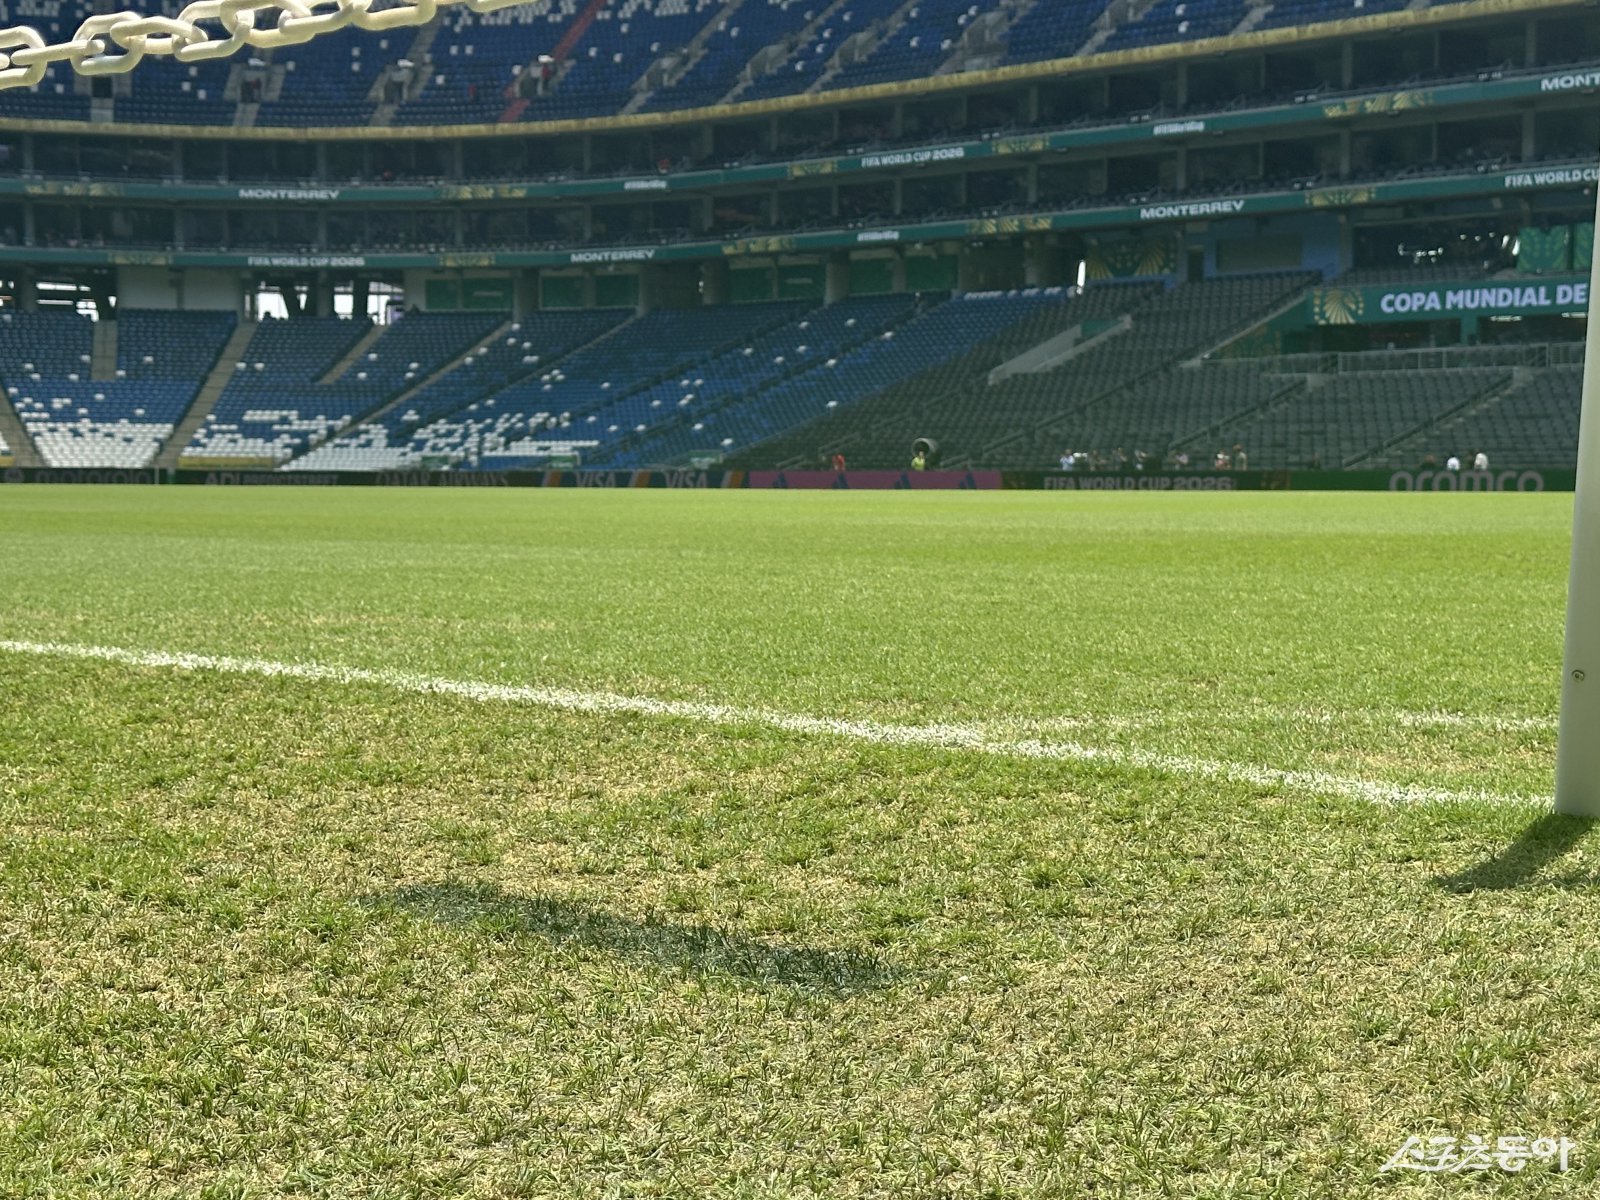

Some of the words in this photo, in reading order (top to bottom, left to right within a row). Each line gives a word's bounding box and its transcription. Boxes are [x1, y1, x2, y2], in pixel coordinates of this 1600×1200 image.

[861, 156, 881, 168] FIFA
[881, 153, 912, 166] WORLD
[913, 151, 932, 163] CUP
[932, 147, 965, 160] 2026
[1504, 174, 1533, 188] FIFA
[1534, 169, 1581, 185] WORLD
[238, 189, 340, 200] MONTERREY
[1139, 200, 1245, 219] MONTERREY
[247, 256, 271, 267] FIFA
[271, 256, 308, 267] WORLD
[309, 256, 329, 267] CUP
[330, 256, 366, 267] 2026
[570, 249, 655, 263] MONTERREY
[1380, 292, 1442, 314] COPA
[1445, 286, 1551, 310] MUNDIAL
[1555, 283, 1588, 305] DE
[573, 471, 616, 488] VISA
[663, 471, 708, 488] VISA
[1042, 476, 1076, 490] FIFA
[1077, 476, 1136, 490] WORLD
[1138, 476, 1171, 490] CUP
[1172, 475, 1233, 490] 2026
